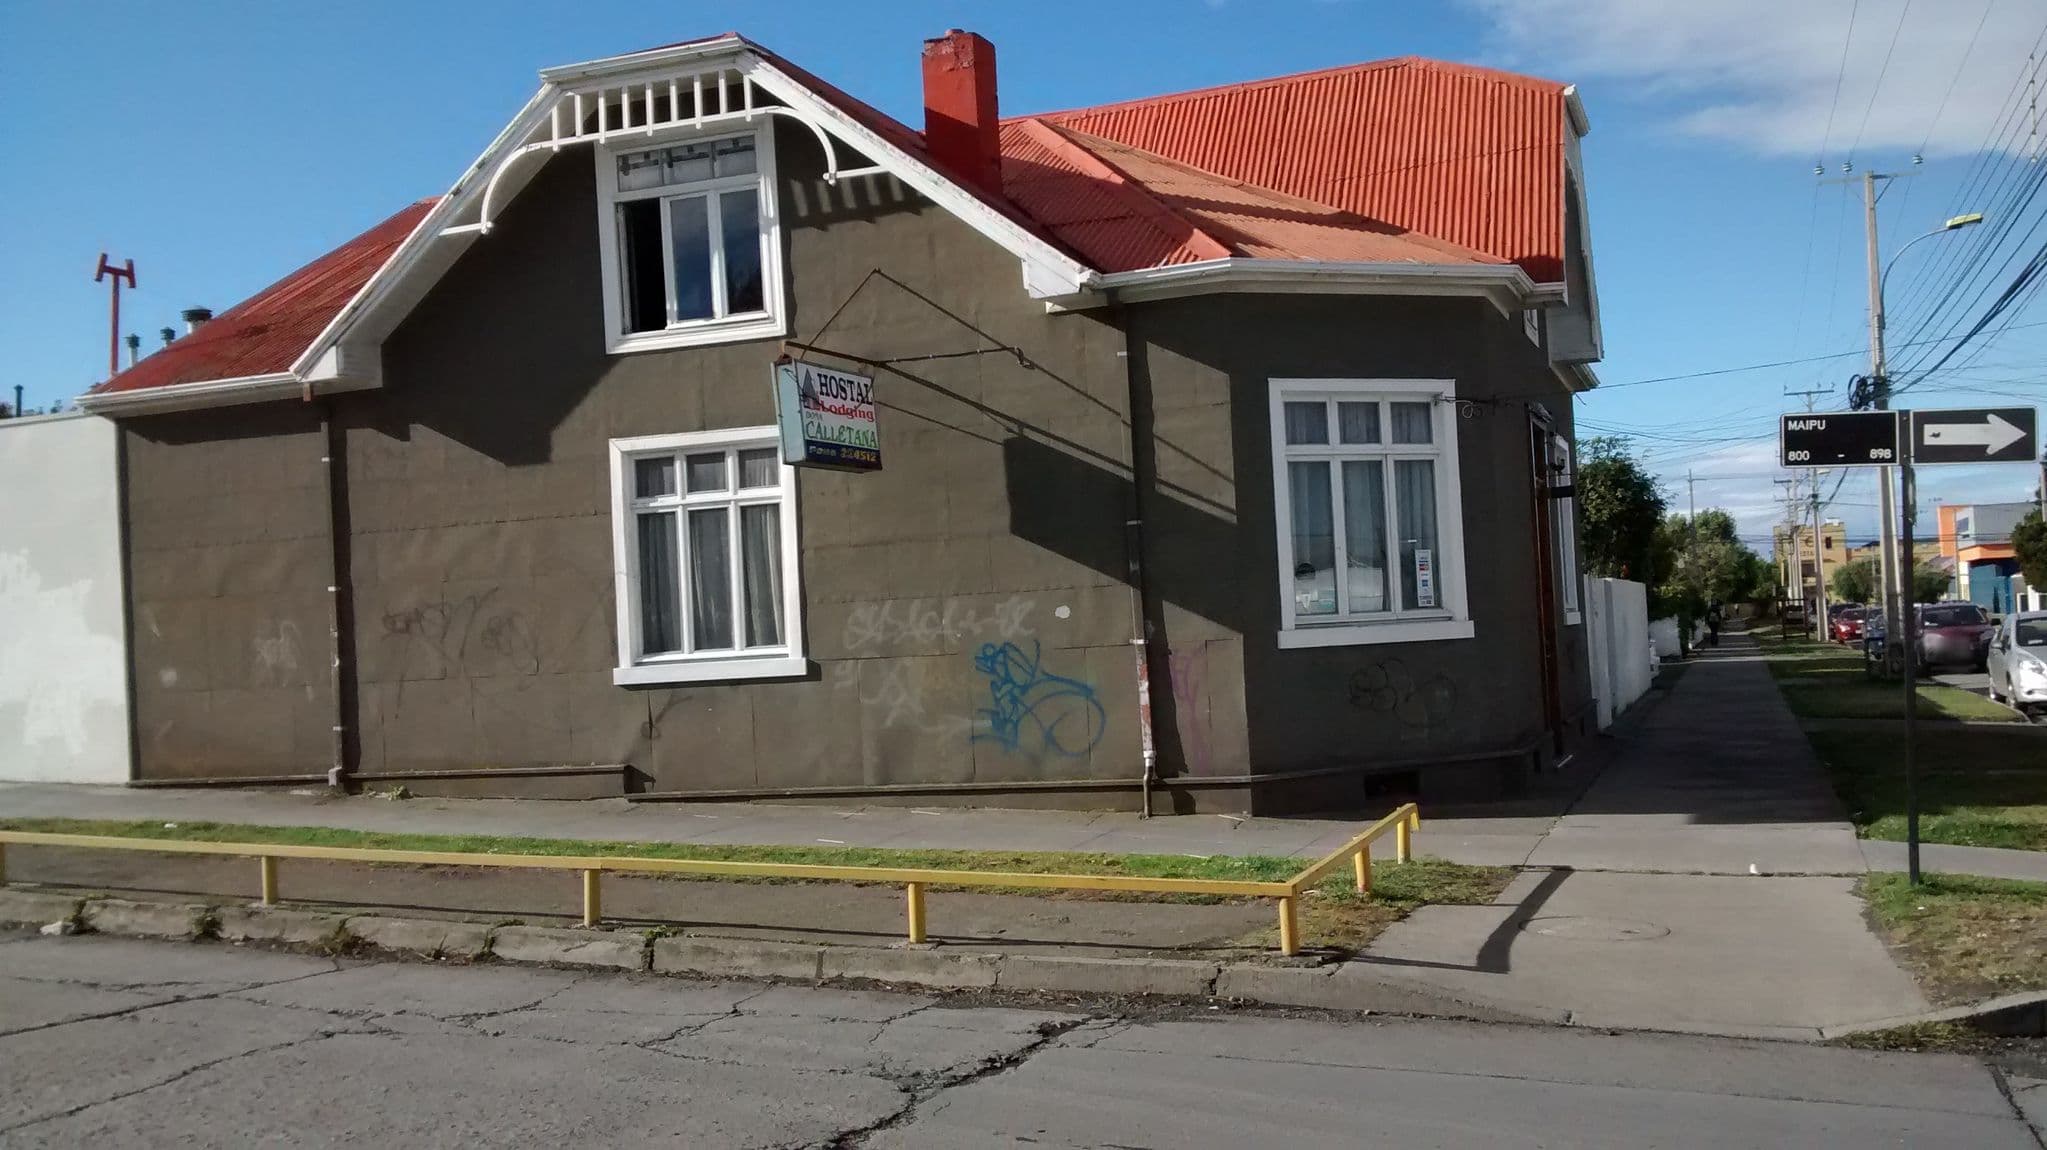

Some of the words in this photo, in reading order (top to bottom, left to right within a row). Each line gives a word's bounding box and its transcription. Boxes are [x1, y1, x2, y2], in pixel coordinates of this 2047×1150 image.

[817, 373, 873, 405] HOSTAL
[819, 400, 874, 422] Lodging
[806, 421, 878, 447] CALLETANA
[1788, 419, 1826, 430] MAIPU
[1788, 450, 1810, 461] 800
[1869, 448, 1892, 459] 898
